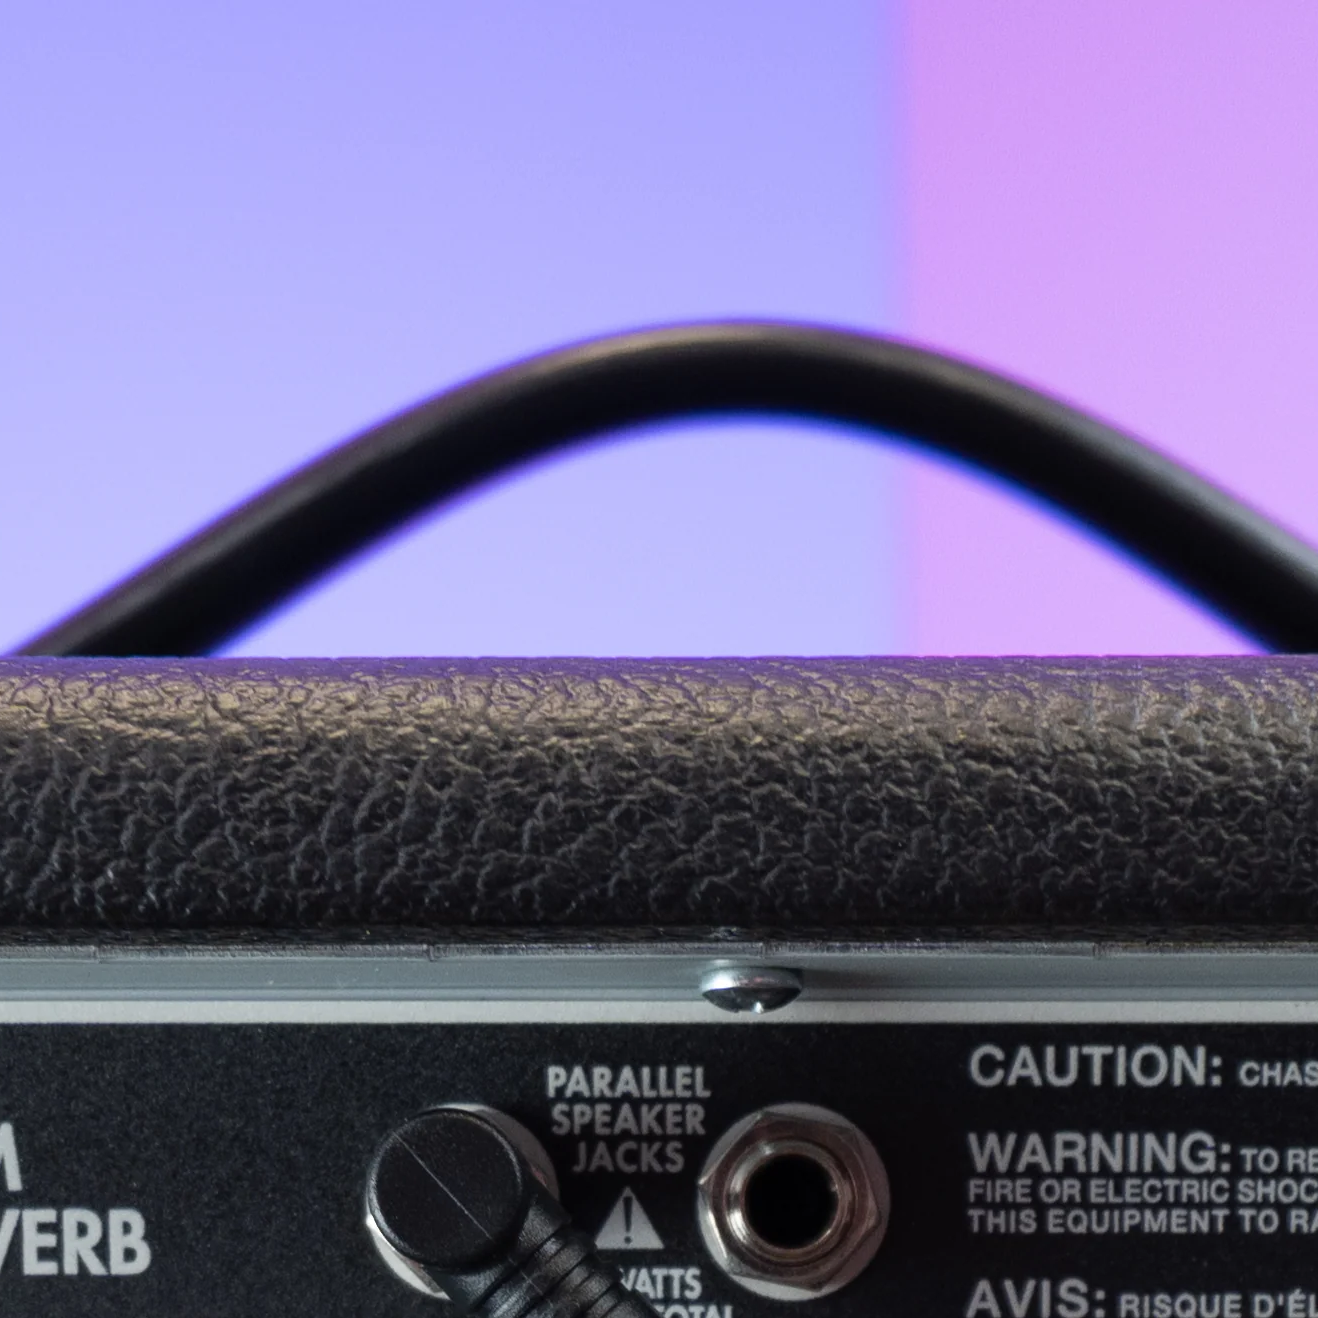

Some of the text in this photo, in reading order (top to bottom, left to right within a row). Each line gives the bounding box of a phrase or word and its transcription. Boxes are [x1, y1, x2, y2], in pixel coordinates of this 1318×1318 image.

[546, 1064, 711, 1098] PARALLEL
[969, 1044, 1222, 1088] CAUTION:
[551, 1101, 706, 1135] SPEAKER
[573, 1140, 685, 1174] JACKS
[968, 1130, 1231, 1174] WARNING:
[1239, 1147, 1280, 1174] TO
[968, 1177, 1033, 1204] FIRE
[1038, 1177, 1082, 1204] OR
[1089, 1177, 1230, 1204] ELECTRIC
[967, 1208, 1038, 1235] THIS
[1047, 1207, 1231, 1234] EQUIPMENT
[1237, 1207, 1280, 1234] TO
